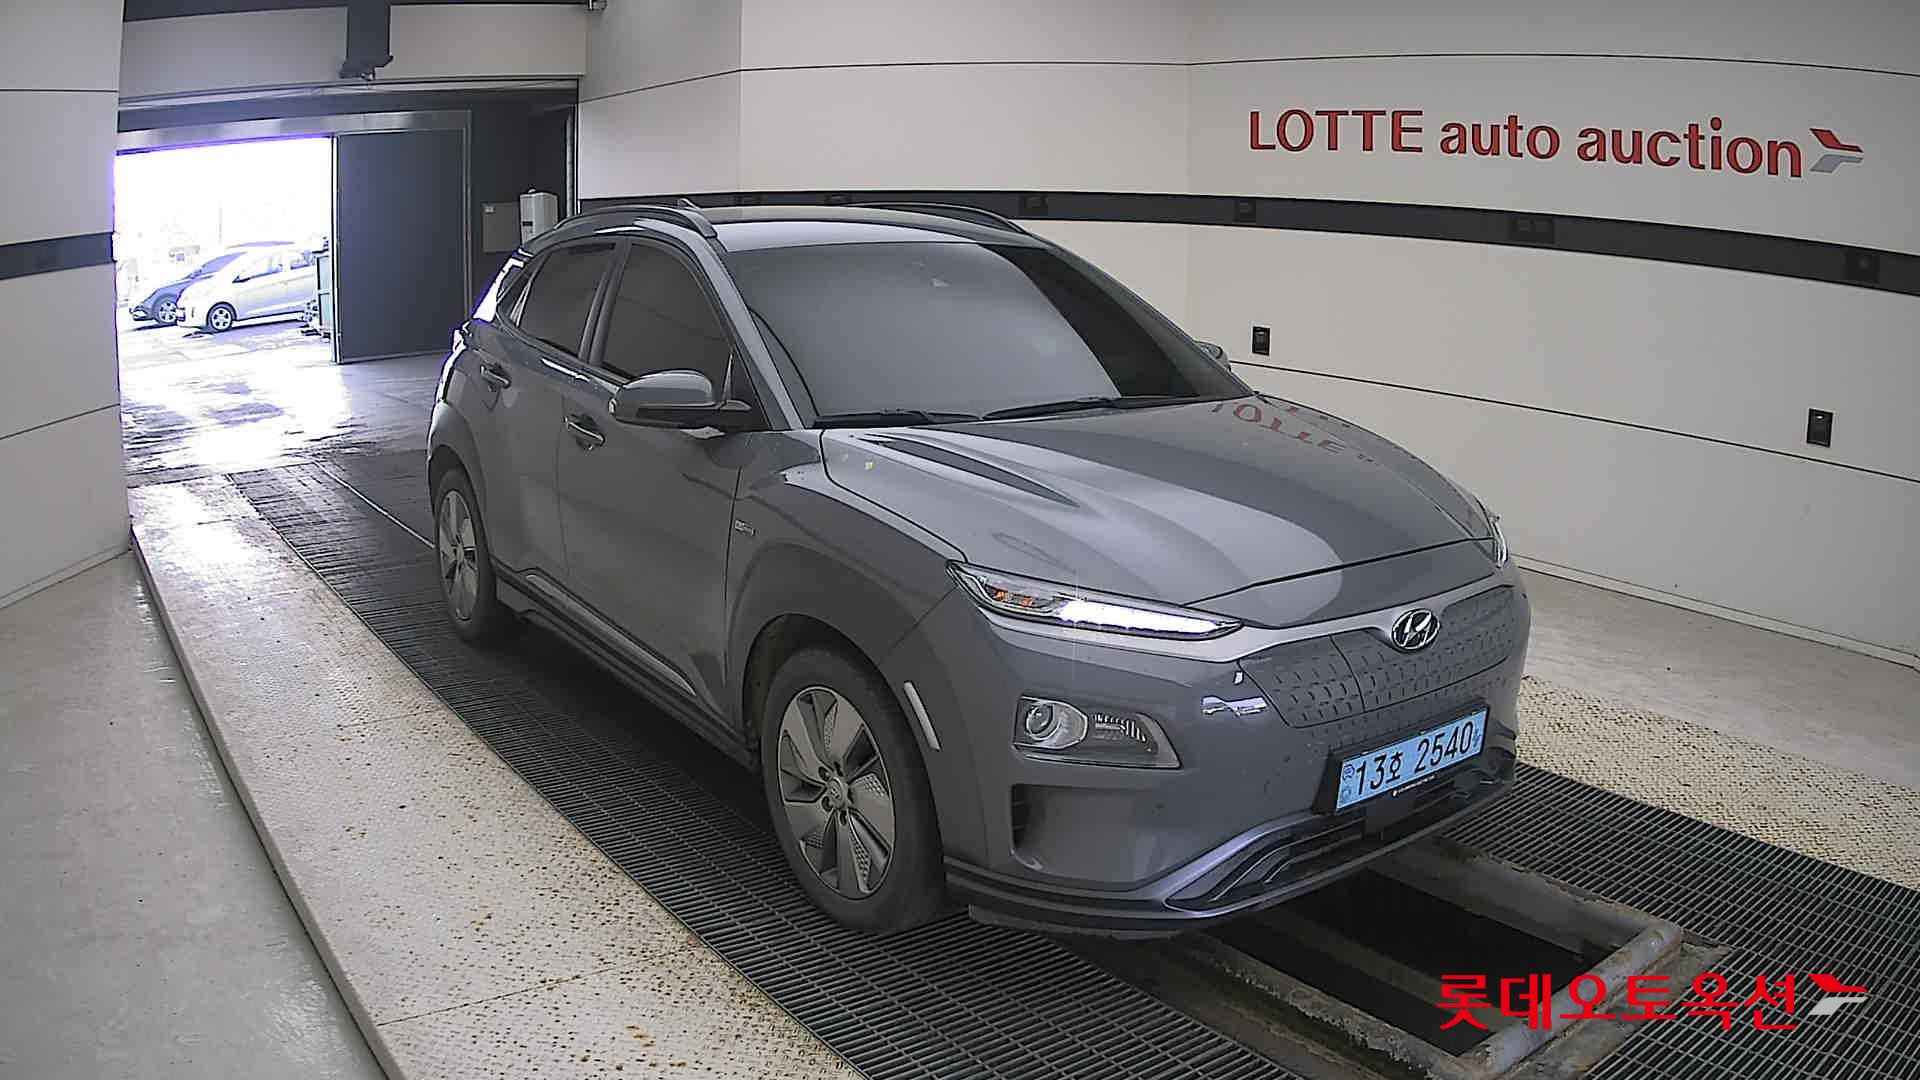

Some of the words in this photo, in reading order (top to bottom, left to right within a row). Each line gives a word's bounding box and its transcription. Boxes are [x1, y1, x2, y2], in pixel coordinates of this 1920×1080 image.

[1249, 110, 1424, 153] LOTTE
[1440, 115, 1561, 160] auto
[1576, 117, 1803, 178] auction
[1356, 751, 1403, 795] 13호
[1414, 721, 1473, 773] 2540
